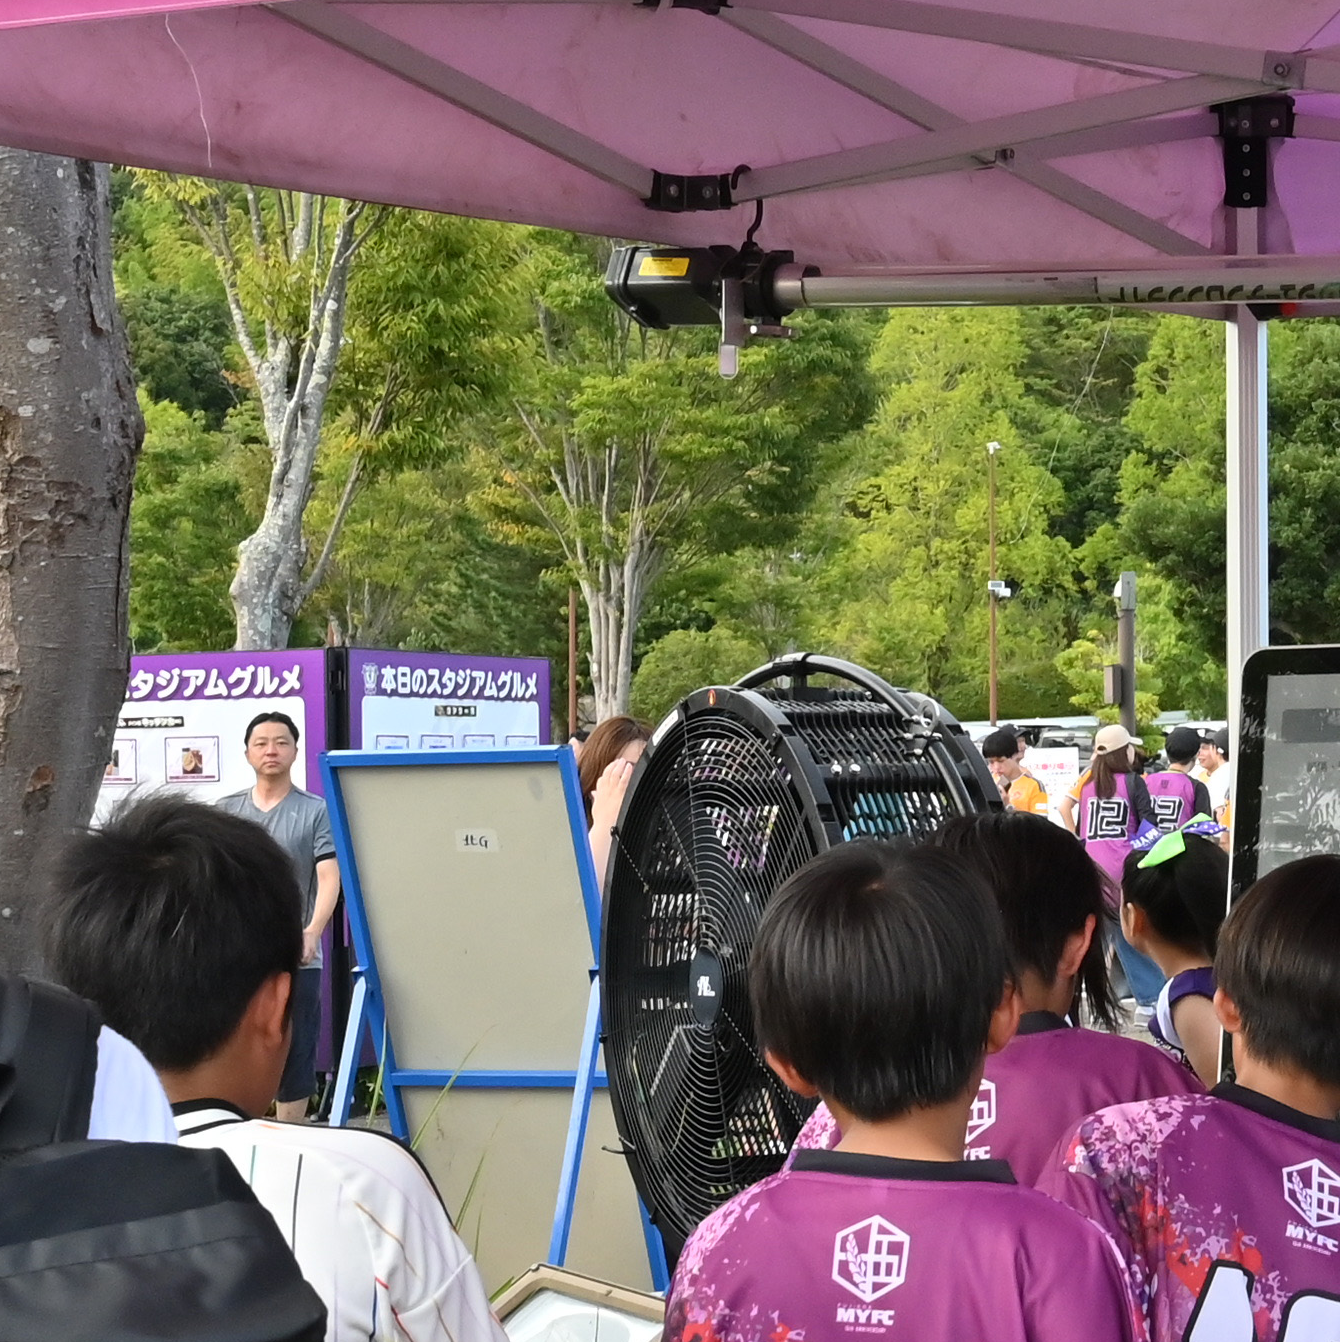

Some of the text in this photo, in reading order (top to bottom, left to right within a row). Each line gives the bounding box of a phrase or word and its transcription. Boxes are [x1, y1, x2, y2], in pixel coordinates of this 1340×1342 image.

[125, 665, 302, 699] タジアムグルメ
[380, 664, 538, 699] 本日のスタジアムグルメ
[1087, 796, 1129, 841] 12
[963, 1146, 991, 1161] FC
[1285, 1224, 1339, 1253] MYFC
[836, 1307, 895, 1326] MYFC
